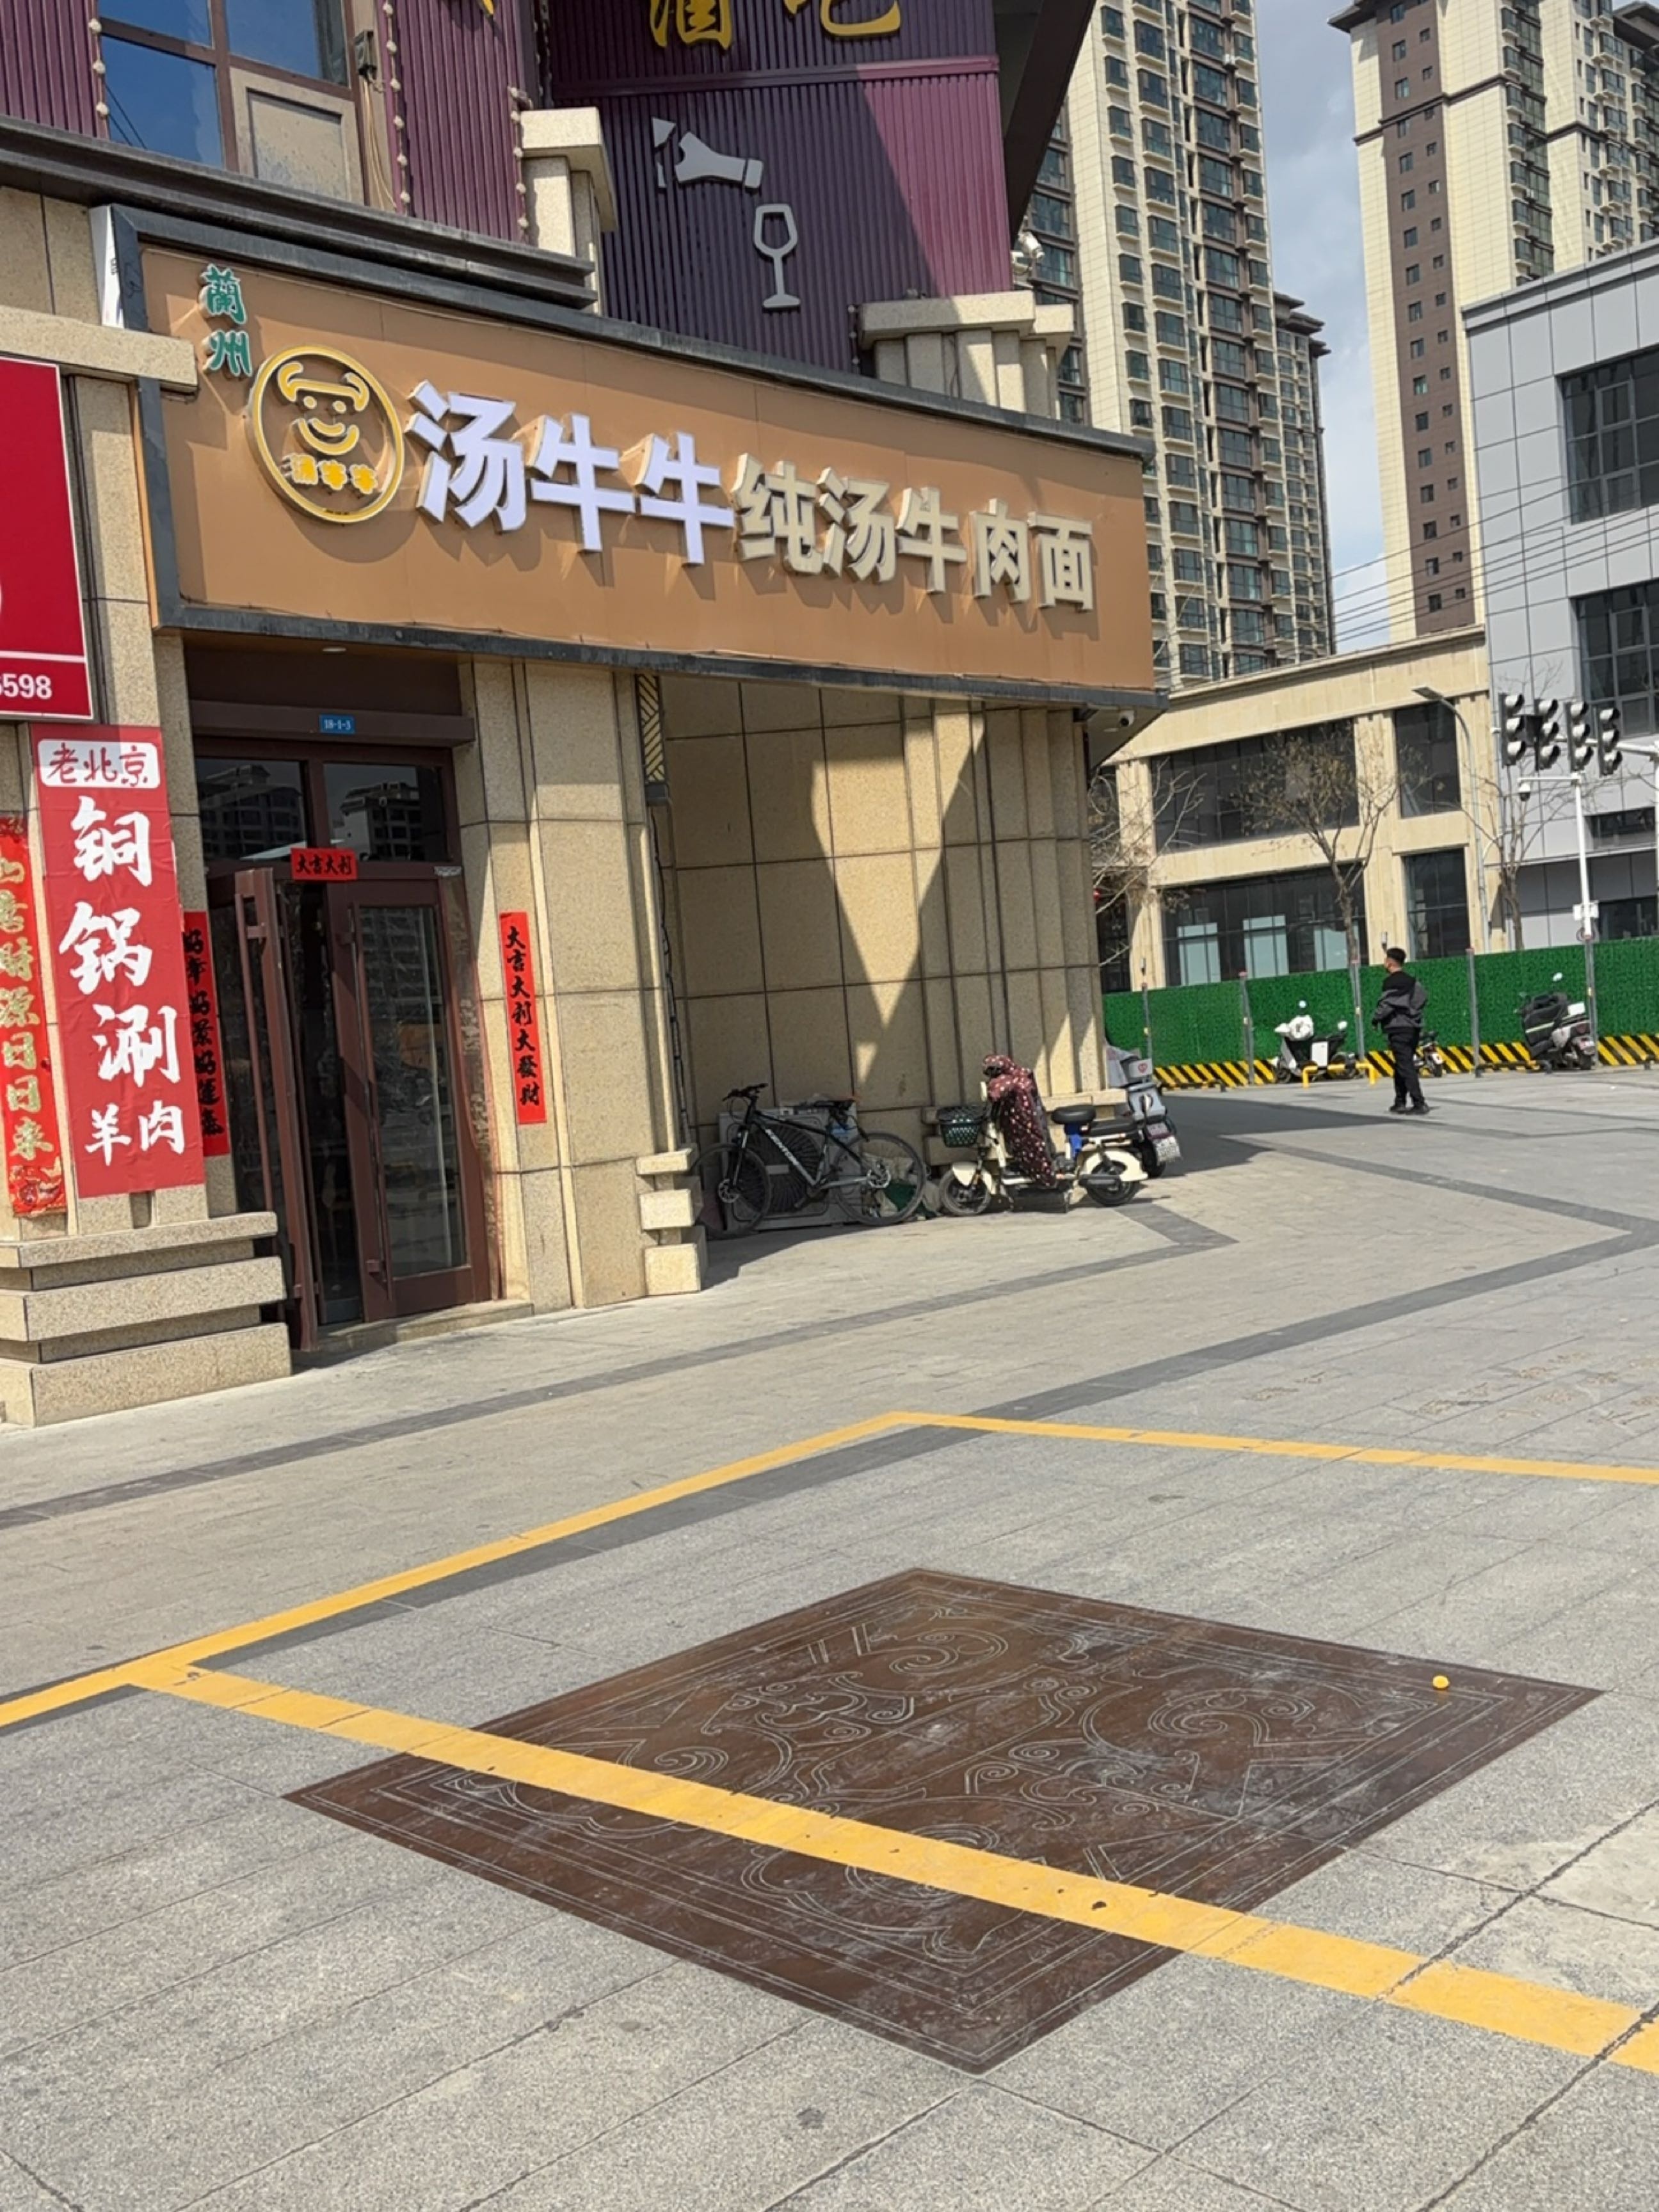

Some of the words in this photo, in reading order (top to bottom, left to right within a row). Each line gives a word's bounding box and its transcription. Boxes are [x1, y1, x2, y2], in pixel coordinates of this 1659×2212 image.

[49, 742, 149, 786] 老北京
[296, 853, 352, 876] 大吉大利
